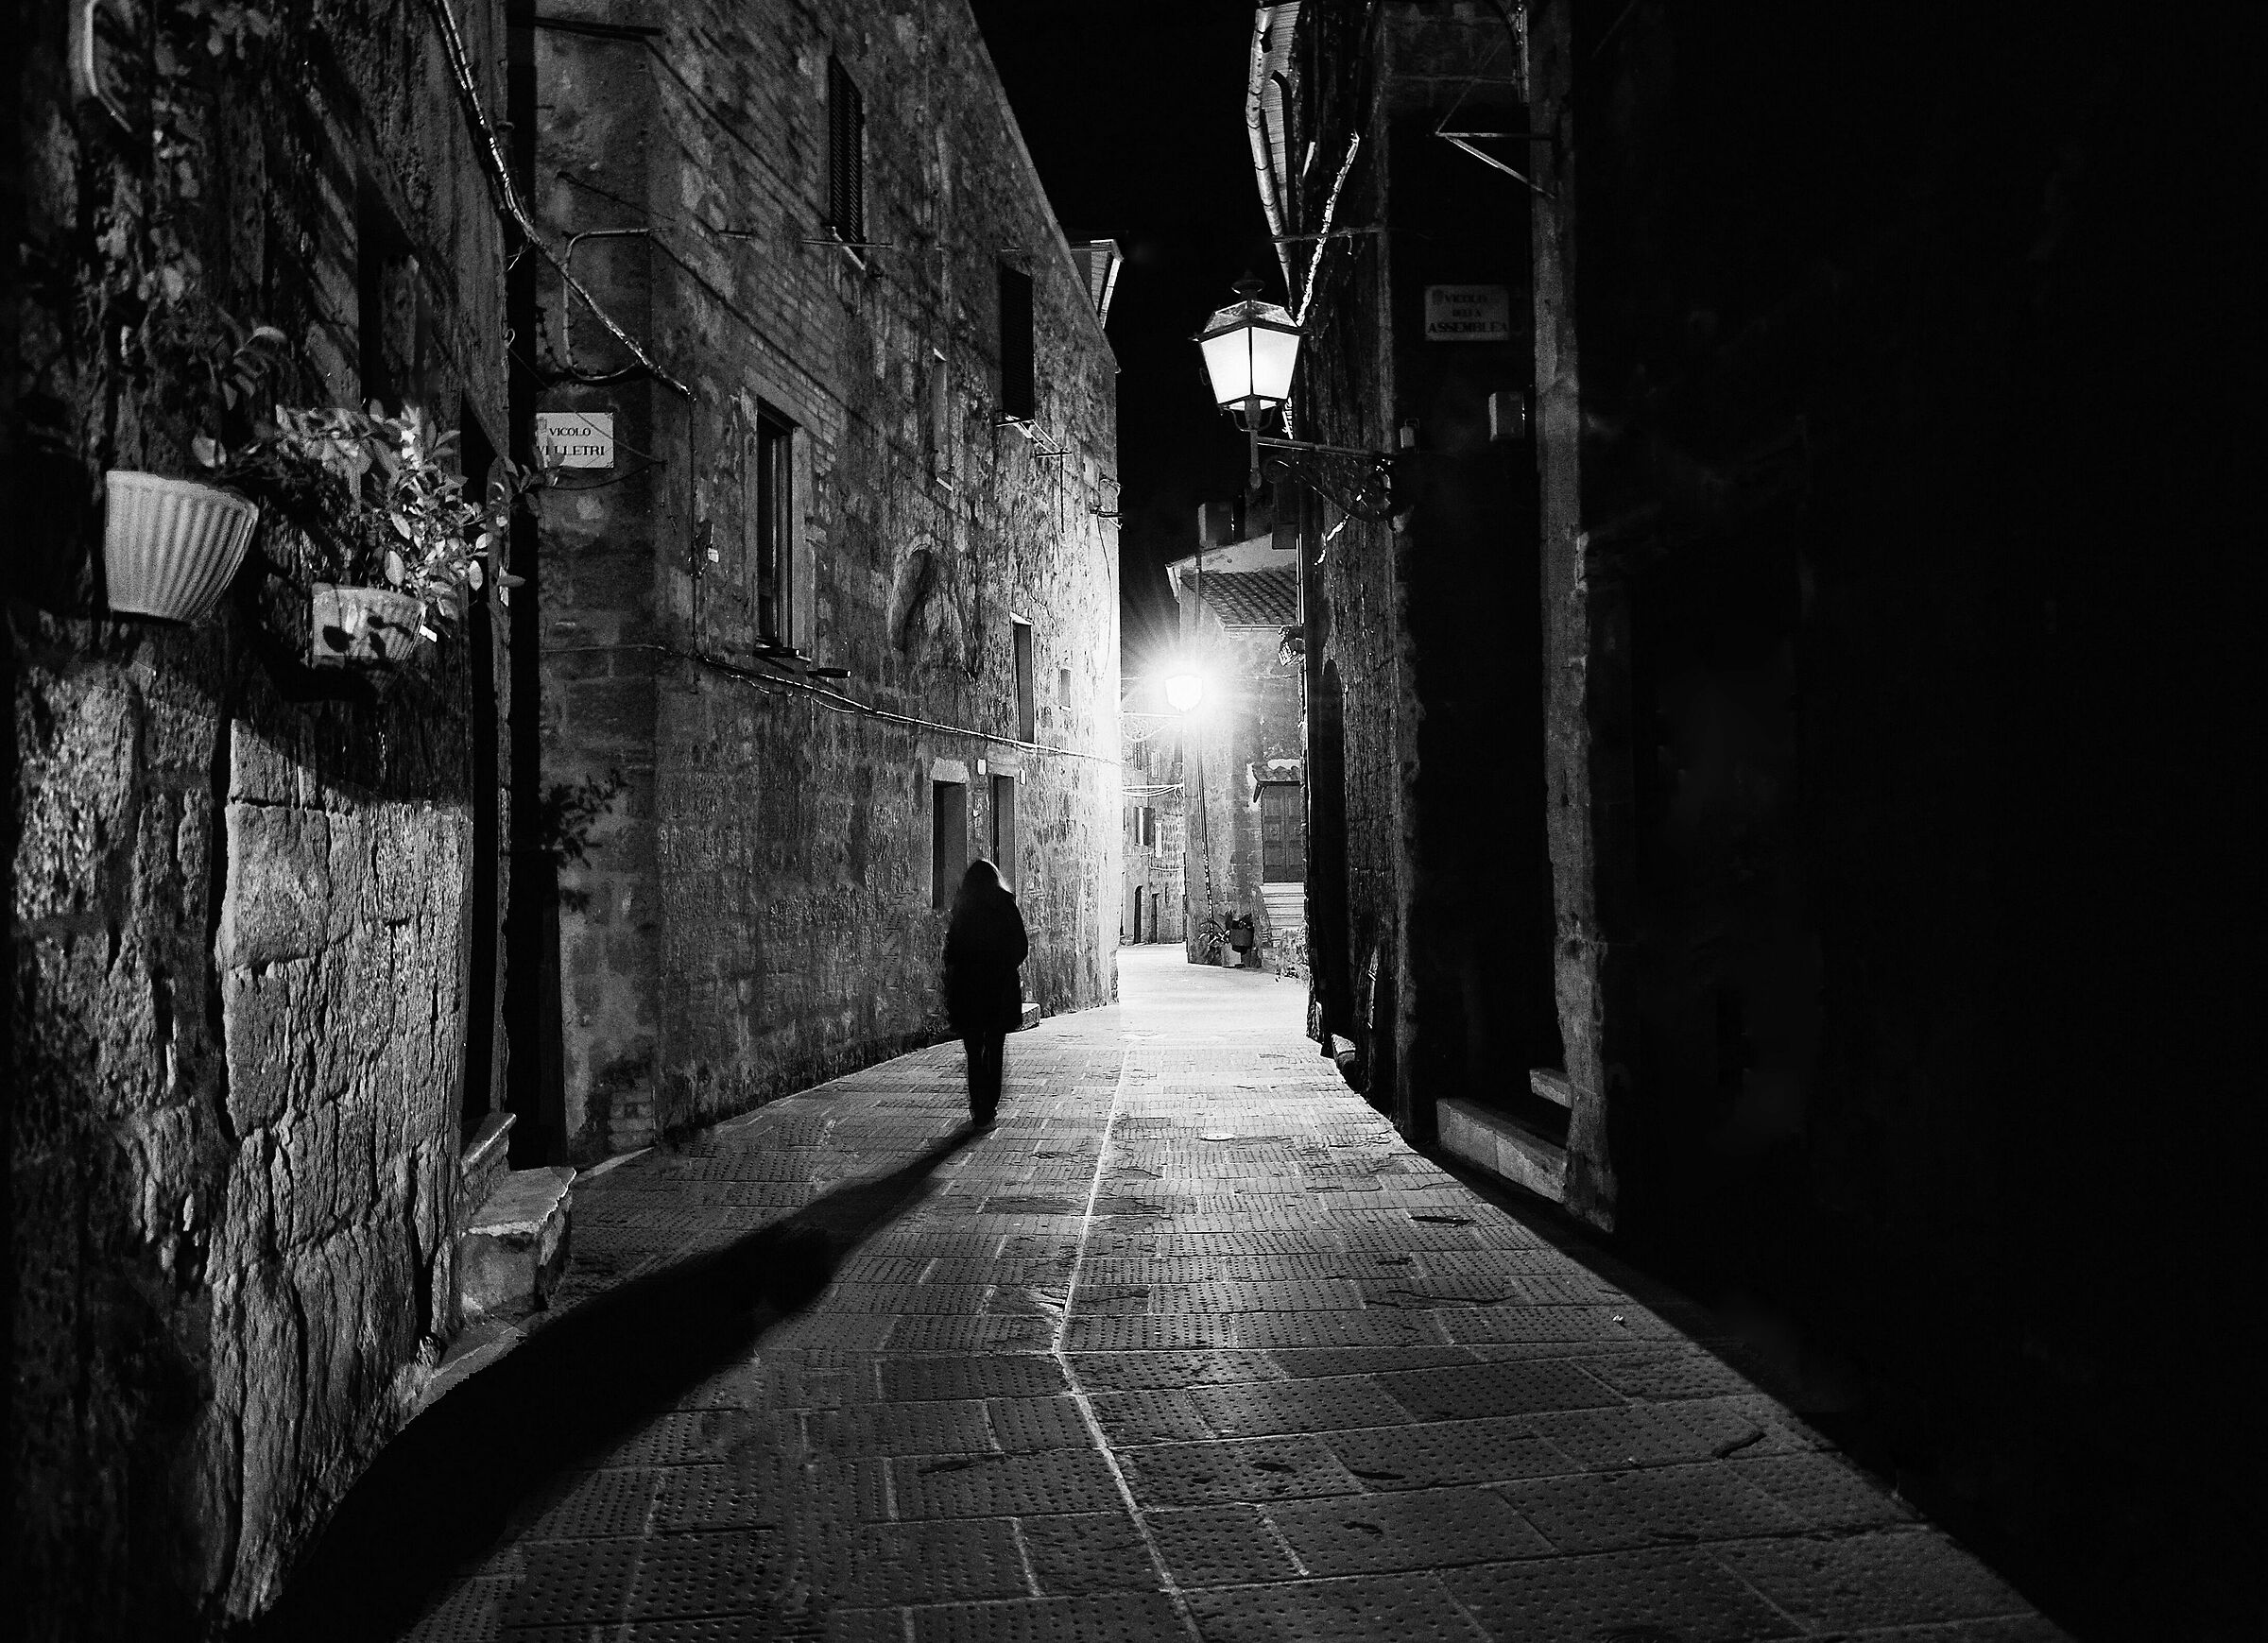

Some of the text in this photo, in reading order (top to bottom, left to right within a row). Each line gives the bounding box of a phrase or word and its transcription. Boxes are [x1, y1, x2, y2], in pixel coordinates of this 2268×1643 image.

[1444, 293, 1488, 303] VICOLO
[1427, 322, 1509, 334] ASSEMBLEA
[549, 427, 592, 436] VICOLO
